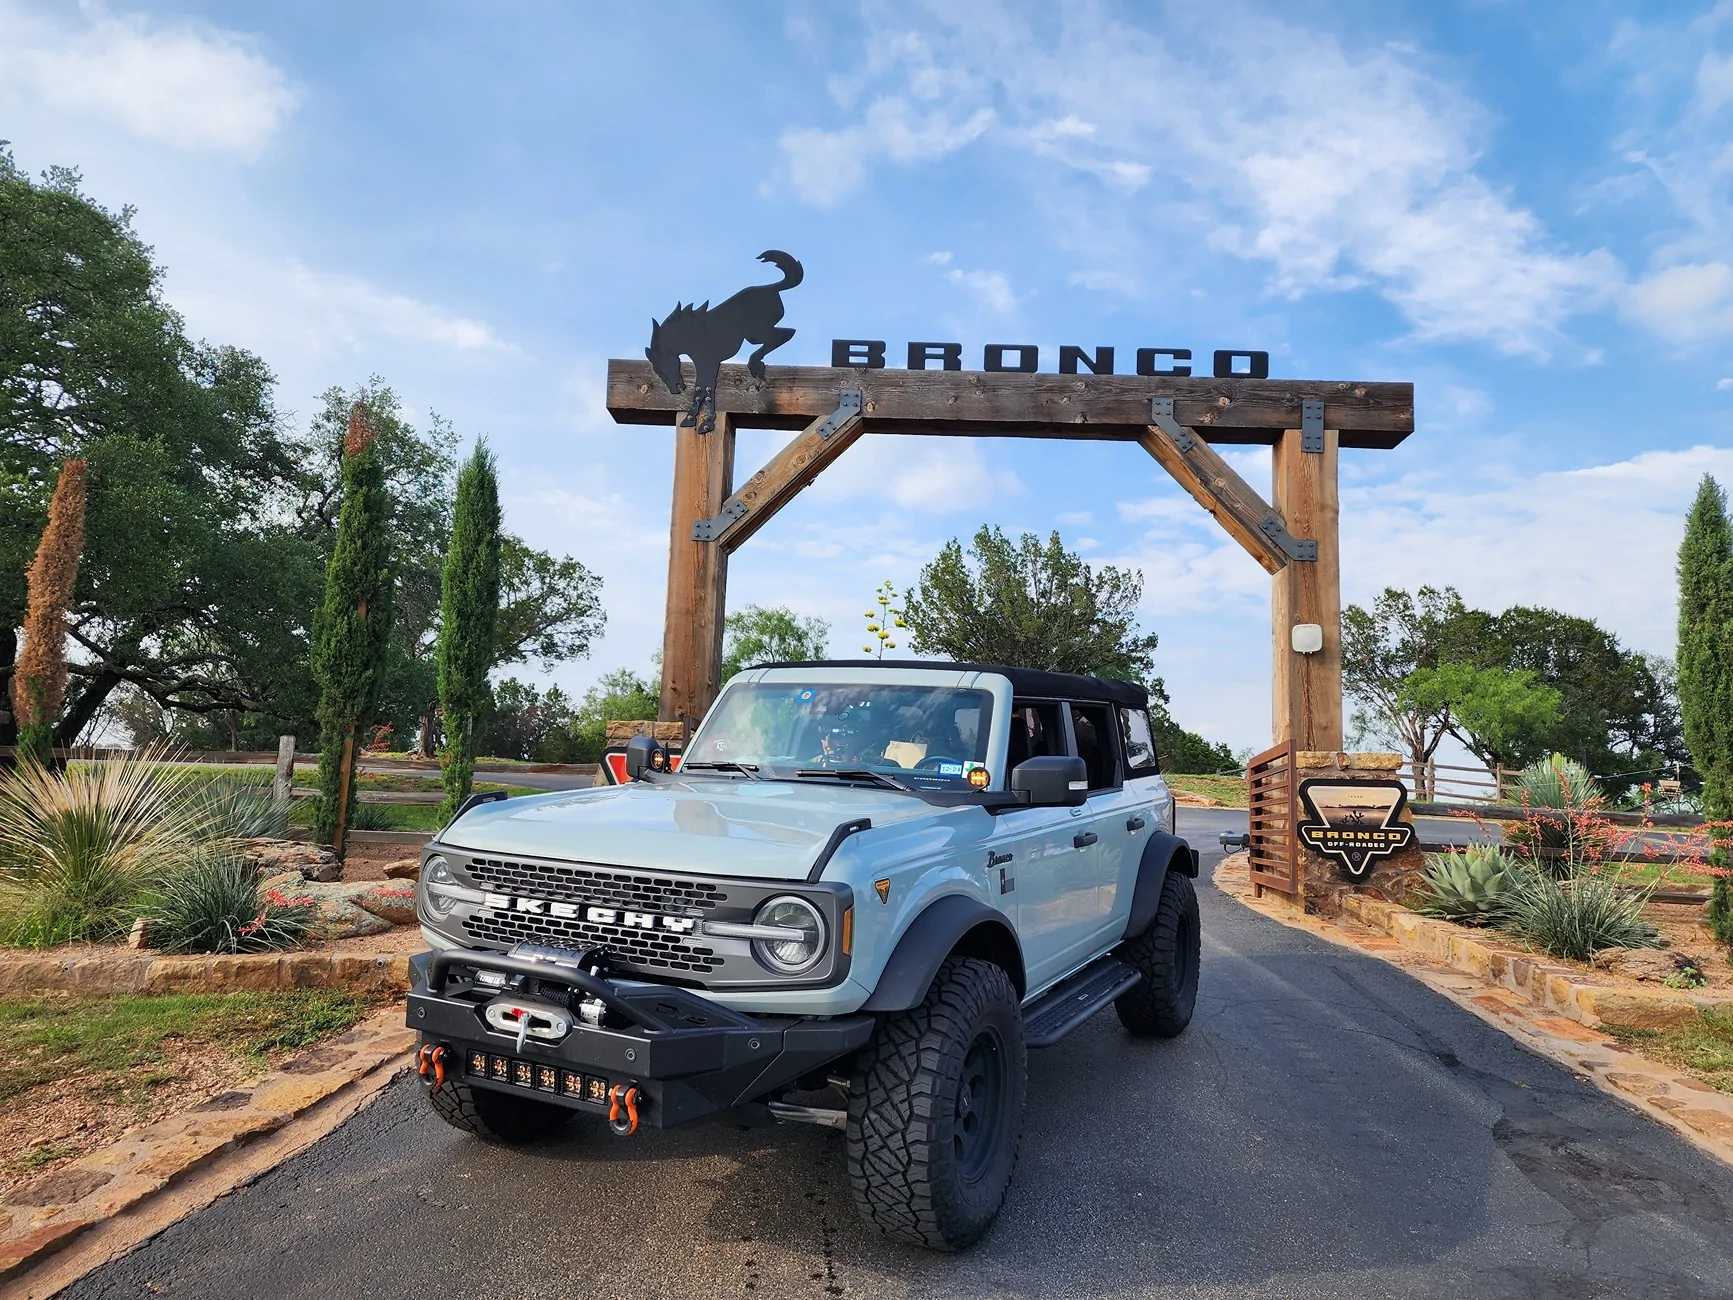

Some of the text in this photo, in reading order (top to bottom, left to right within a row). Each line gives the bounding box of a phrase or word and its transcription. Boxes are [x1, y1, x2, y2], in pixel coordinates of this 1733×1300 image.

[832, 339, 1269, 379] BRONCO
[1311, 831, 1401, 840] BRONCO
[484, 892, 695, 932] SKECHY
